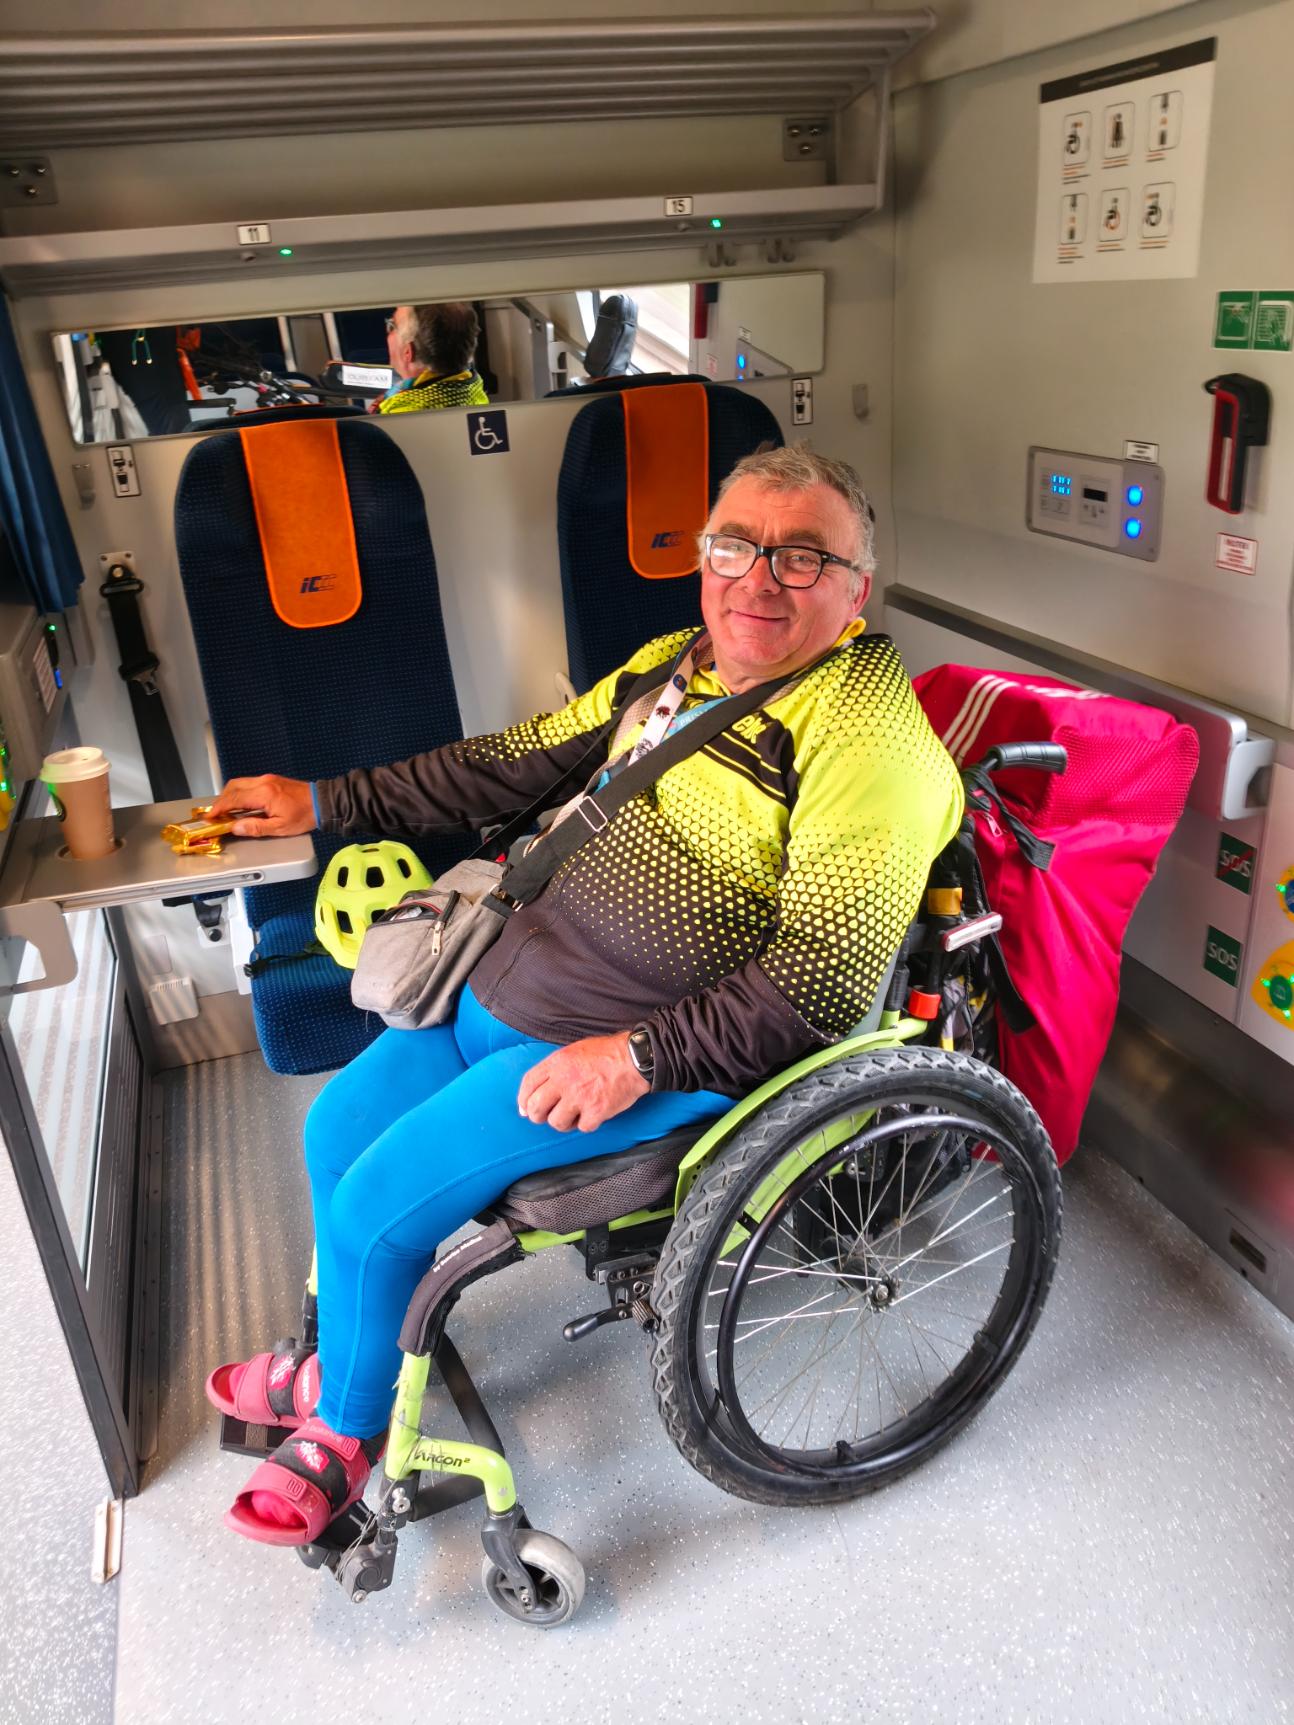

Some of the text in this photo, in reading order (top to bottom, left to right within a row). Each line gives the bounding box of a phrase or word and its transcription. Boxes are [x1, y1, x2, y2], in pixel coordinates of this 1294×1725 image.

[672, 199, 685, 213] 15
[248, 227, 260, 241] 11
[1219, 850, 1251, 878] SOS
[1207, 942, 1238, 971] SOS
